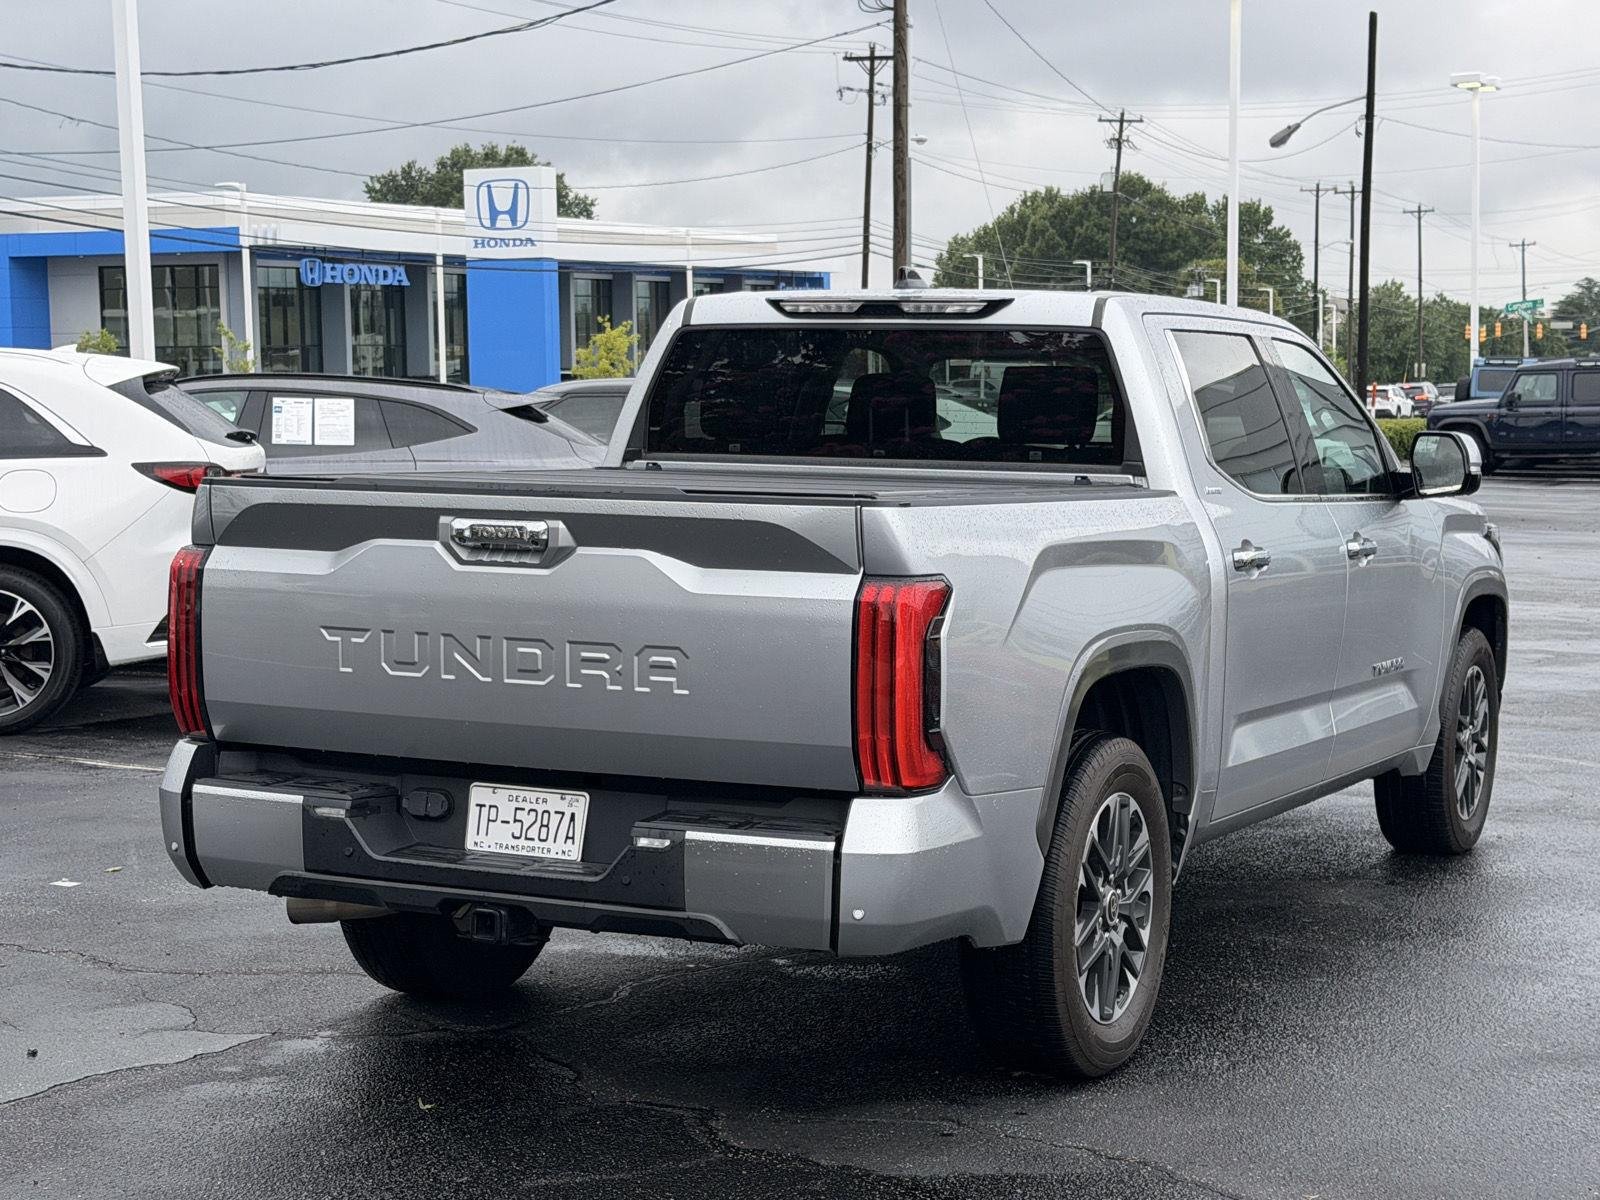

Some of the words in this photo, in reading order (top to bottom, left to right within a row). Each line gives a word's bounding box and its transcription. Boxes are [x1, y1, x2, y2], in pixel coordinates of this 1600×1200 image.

[473, 237, 538, 249] HONDA
[322, 262, 411, 287] HONDA
[475, 526, 521, 540] TOYOTA
[319, 624, 690, 695] TUNDRA
[507, 794, 549, 805] DEALER
[475, 803, 577, 846] TP-5287A
[473, 840, 485, 849] NC
[494, 842, 552, 855] TRANSPORTER
